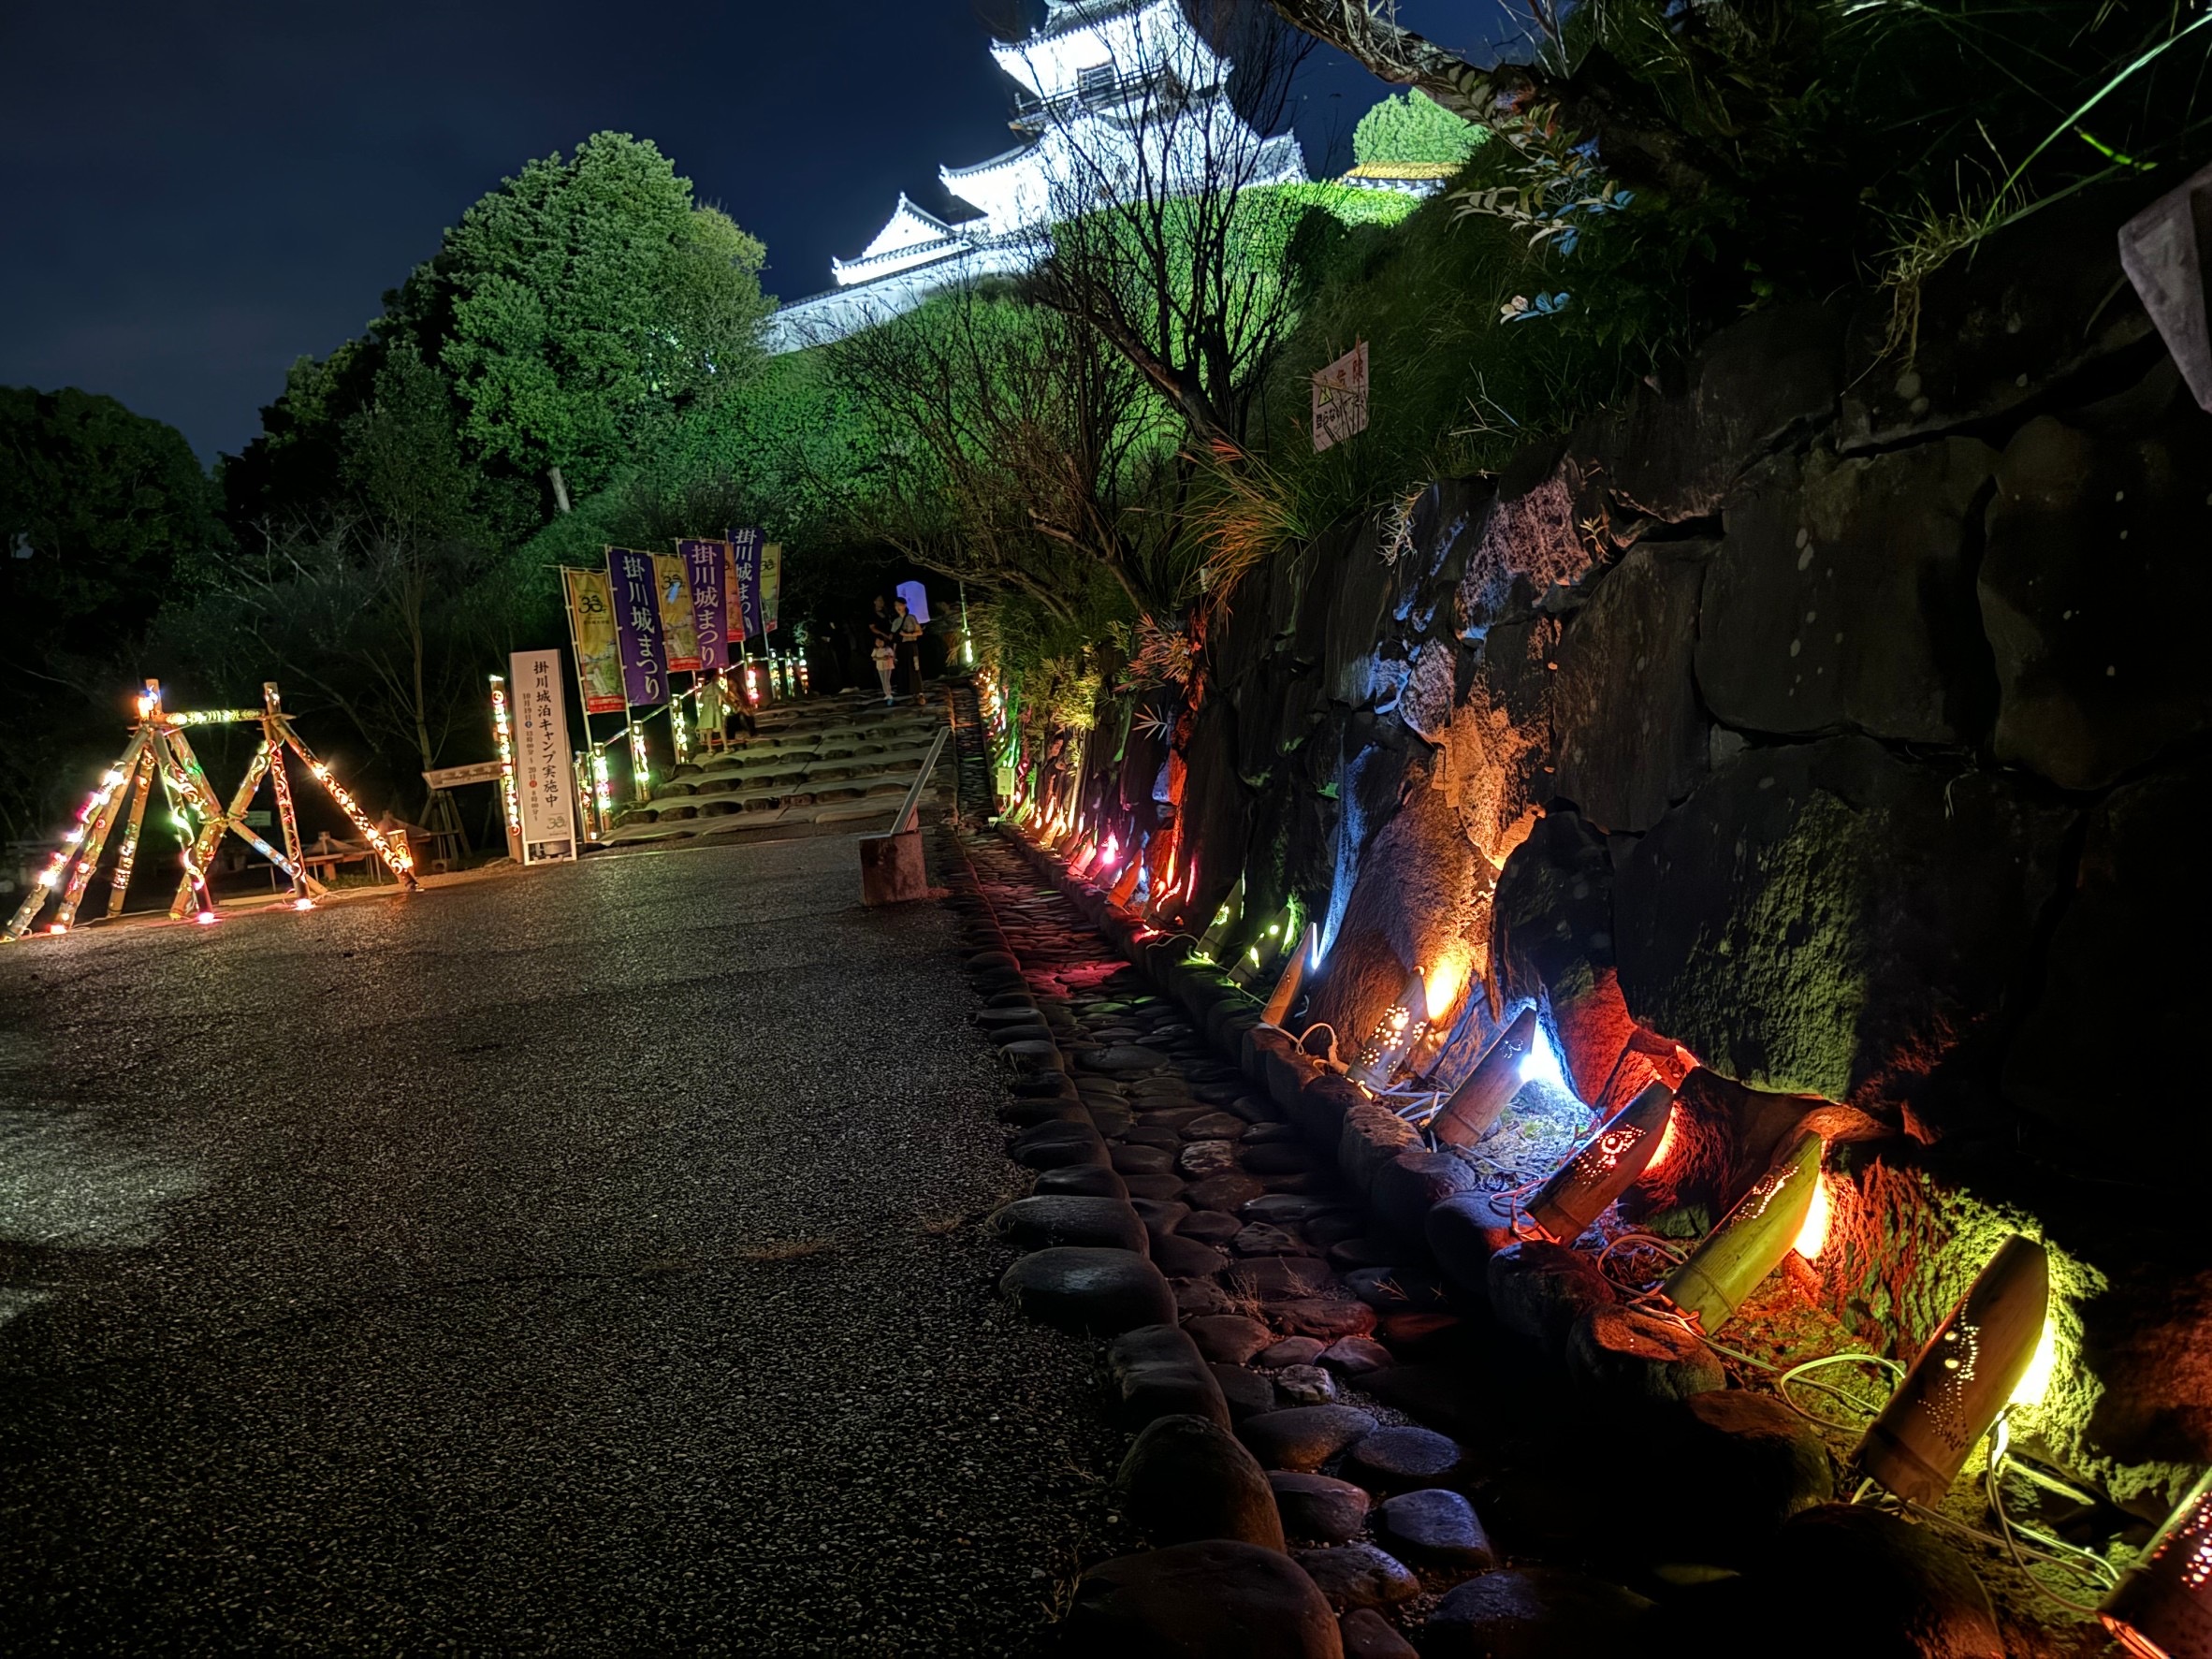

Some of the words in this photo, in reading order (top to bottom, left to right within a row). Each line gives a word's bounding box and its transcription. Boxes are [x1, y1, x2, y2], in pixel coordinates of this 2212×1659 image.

[623, 556, 661, 701] 掛川城まつり
[691, 545, 720, 669] 掛川城まつり
[735, 529, 757, 633] 掛川城まつり
[533, 661, 559, 808] 掛川城泊キャンプ実施中
